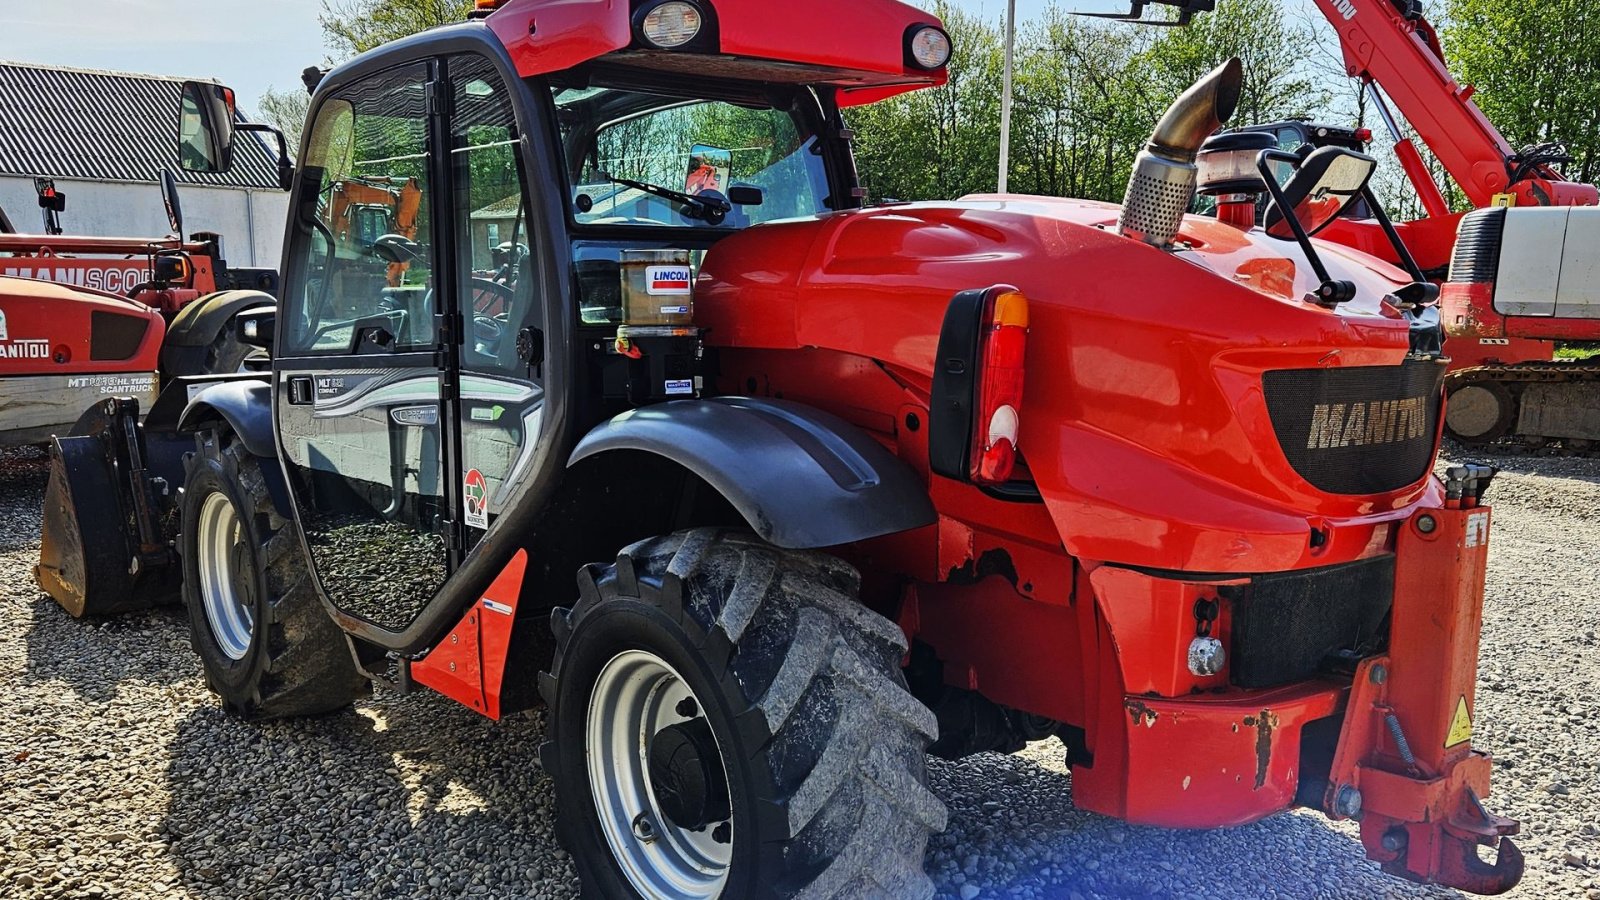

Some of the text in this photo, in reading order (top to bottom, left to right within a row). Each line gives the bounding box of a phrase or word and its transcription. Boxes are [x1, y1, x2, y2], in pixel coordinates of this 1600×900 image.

[67, 377, 89, 388] MT
[130, 377, 159, 385] TURBO
[318, 378, 331, 388] MLT
[100, 384, 154, 394] SCANTRUCK
